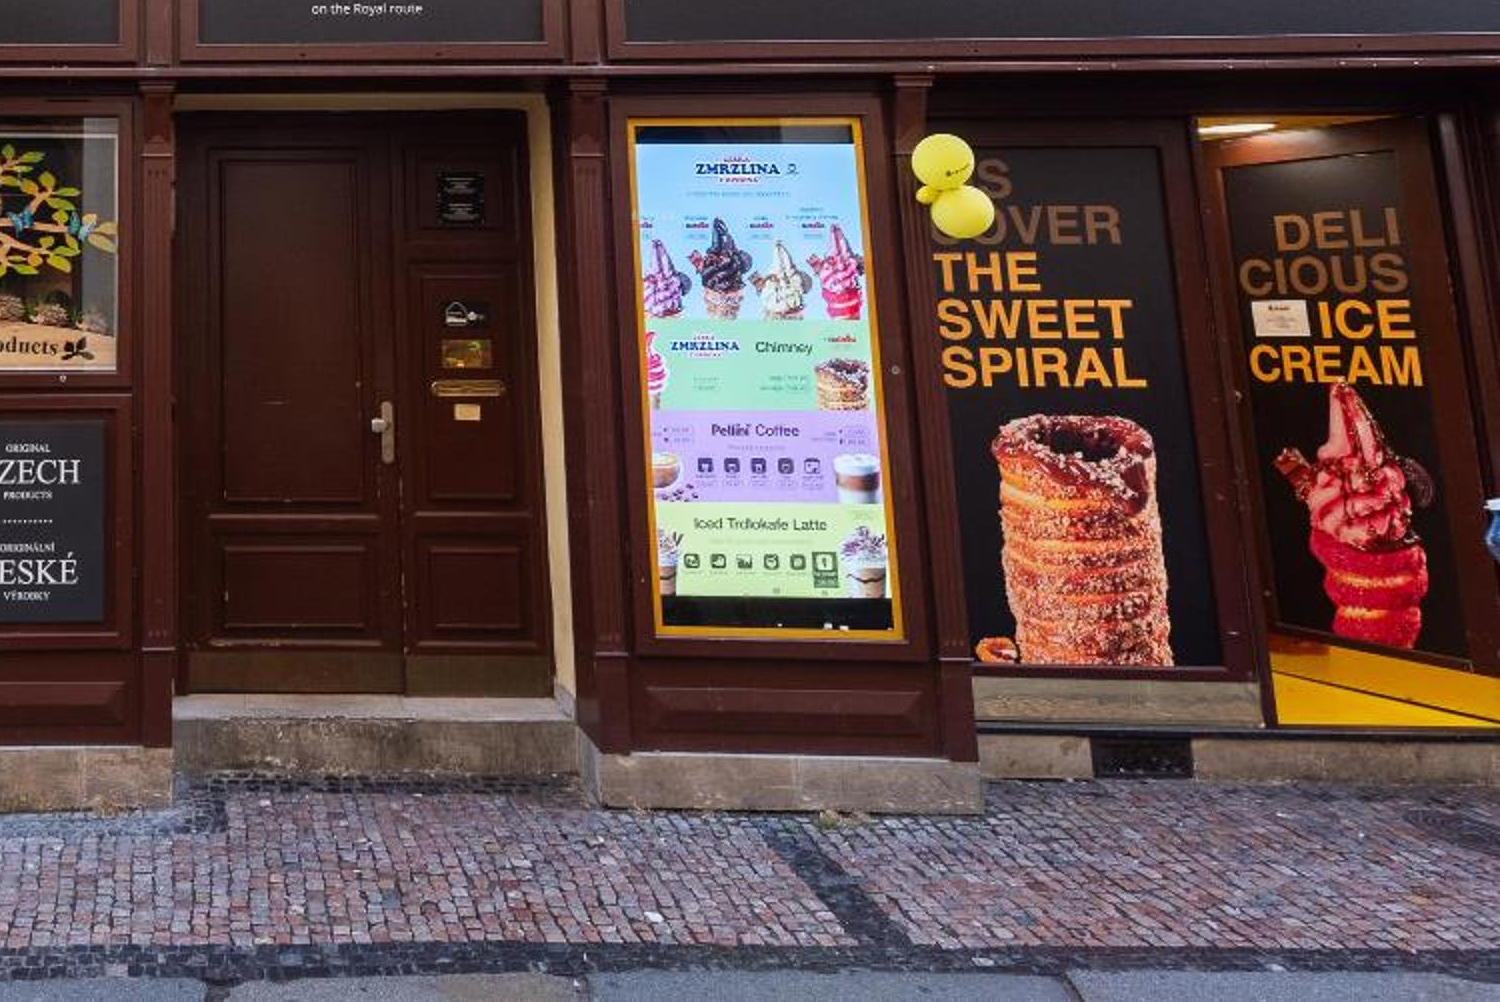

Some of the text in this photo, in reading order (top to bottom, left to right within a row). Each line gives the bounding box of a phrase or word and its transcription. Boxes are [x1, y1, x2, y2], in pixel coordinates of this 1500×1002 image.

[311, 2, 424, 17] on the Royal route
[695, 163, 781, 175] ZMRZLINA
[931, 204, 1123, 246] OVER
[1272, 207, 1401, 252] DELI
[933, 251, 1041, 293] THE
[1239, 252, 1409, 296] CIOUS
[936, 298, 1134, 341] SWEET
[1318, 299, 1416, 339] ICE
[755, 340, 813, 355] Chimney
[941, 345, 1148, 389] SPIRAL
[1250, 344, 1424, 387] CREAM
[5, 443, 52, 453] ORIGINAL
[755, 424, 800, 437] Coffee
[793, 518, 828, 531] Latte
